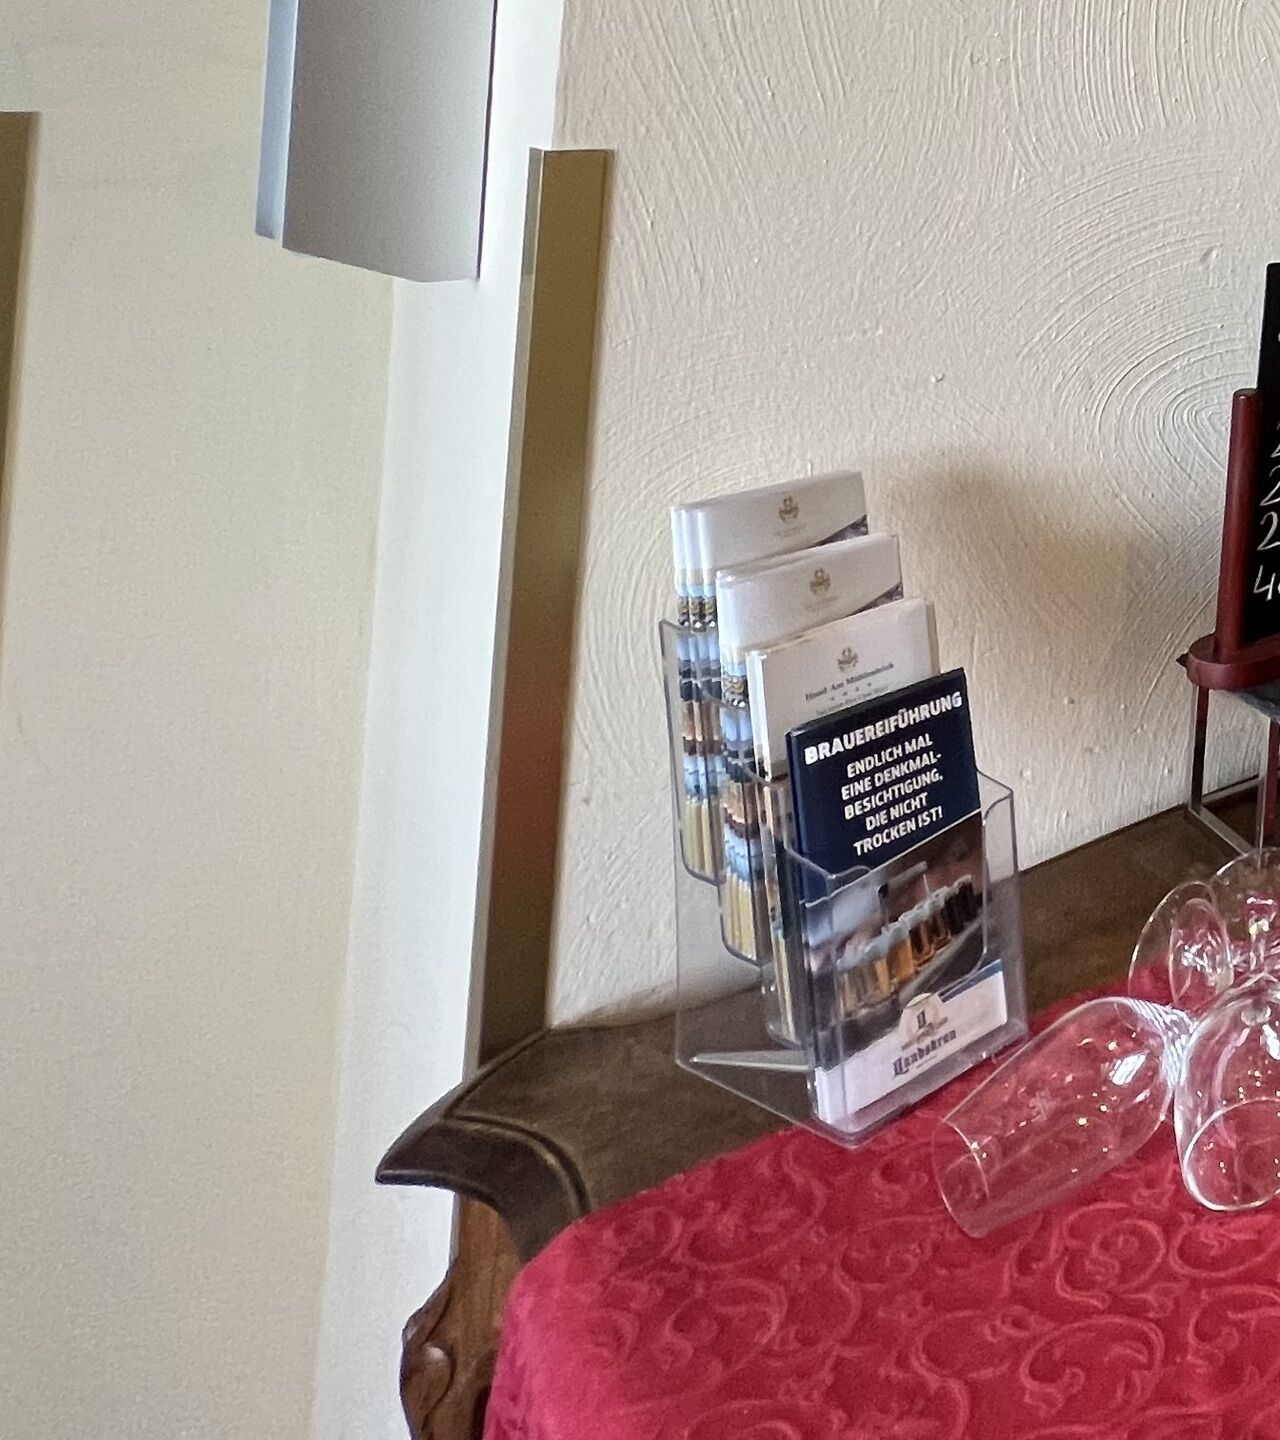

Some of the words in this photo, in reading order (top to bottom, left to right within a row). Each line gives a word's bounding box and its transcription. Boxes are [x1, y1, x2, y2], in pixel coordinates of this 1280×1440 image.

[804, 691, 963, 765] BRAUEREIFÜHRUNG
[841, 776, 872, 800] EINE
[874, 751, 942, 788] DENKMAL-
[847, 745, 903, 778] ENDLICH
[905, 733, 933, 755] MAL
[844, 768, 944, 820] BESICHTIGUNG,
[865, 812, 889, 831] DIE
[890, 791, 928, 821] NICHT
[853, 819, 916, 856] TROCKEN
[918, 805, 943, 828] IST!
